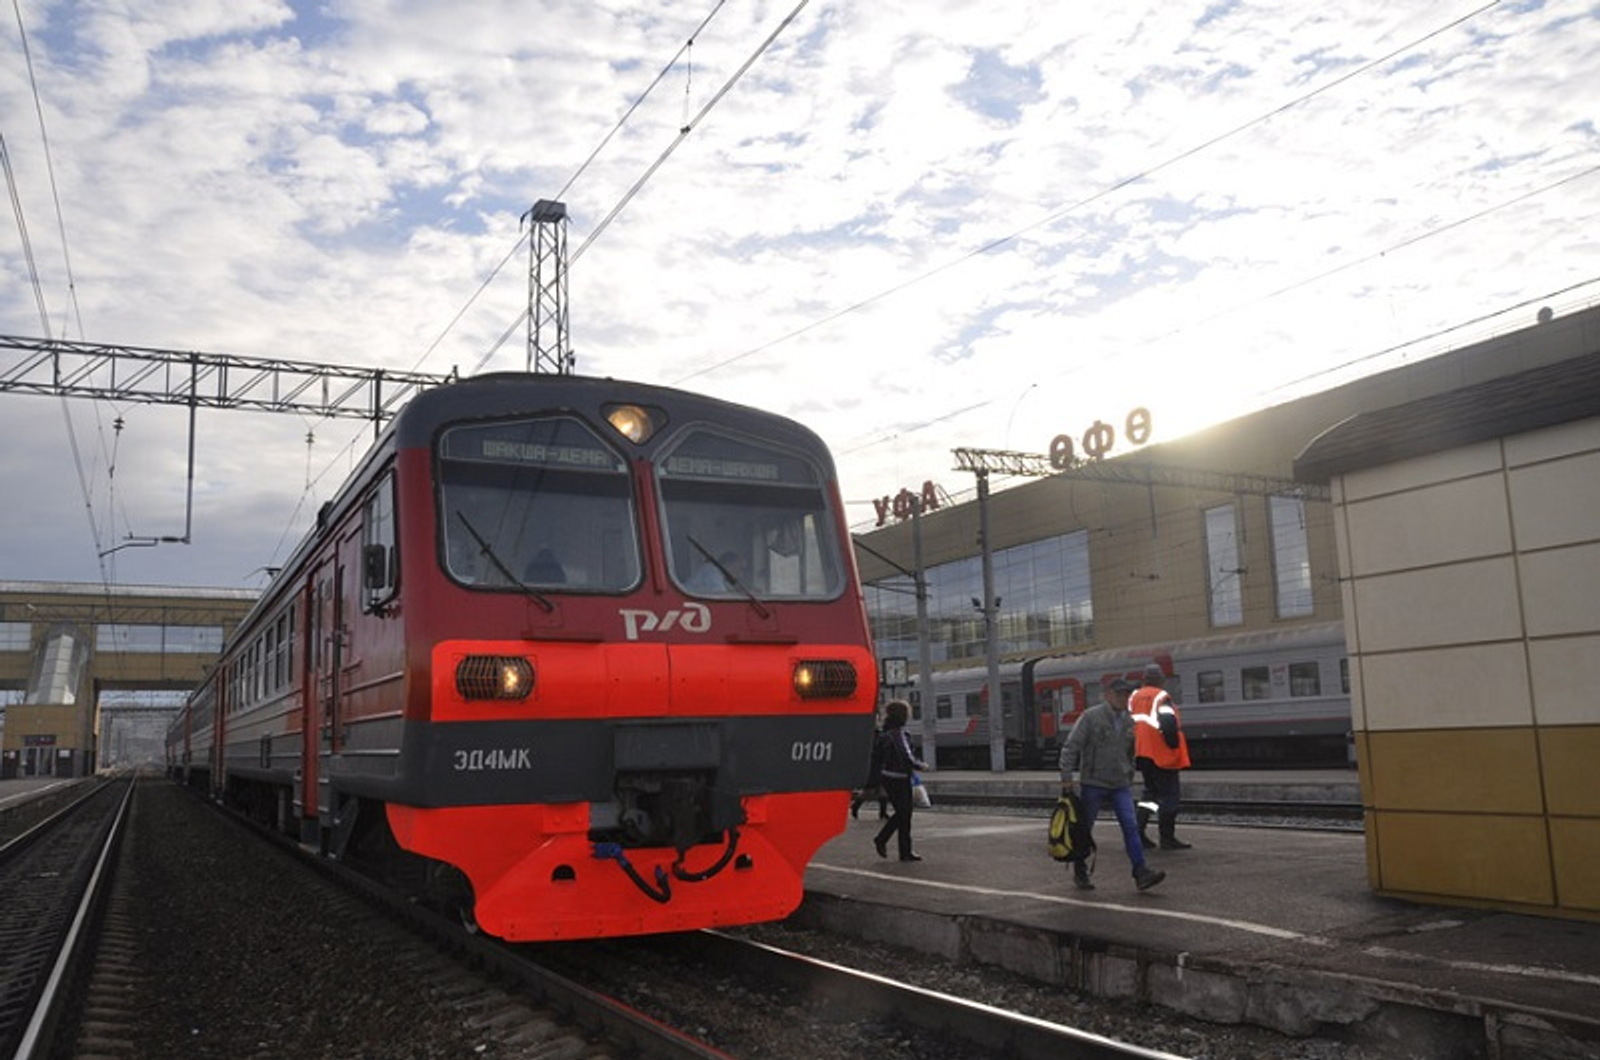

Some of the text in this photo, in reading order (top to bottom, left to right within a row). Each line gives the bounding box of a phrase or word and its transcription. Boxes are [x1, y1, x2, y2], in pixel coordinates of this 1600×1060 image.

[873, 480, 940, 526] УФА
[453, 747, 532, 772] ЭД4МК
[791, 741, 833, 762] 0101
